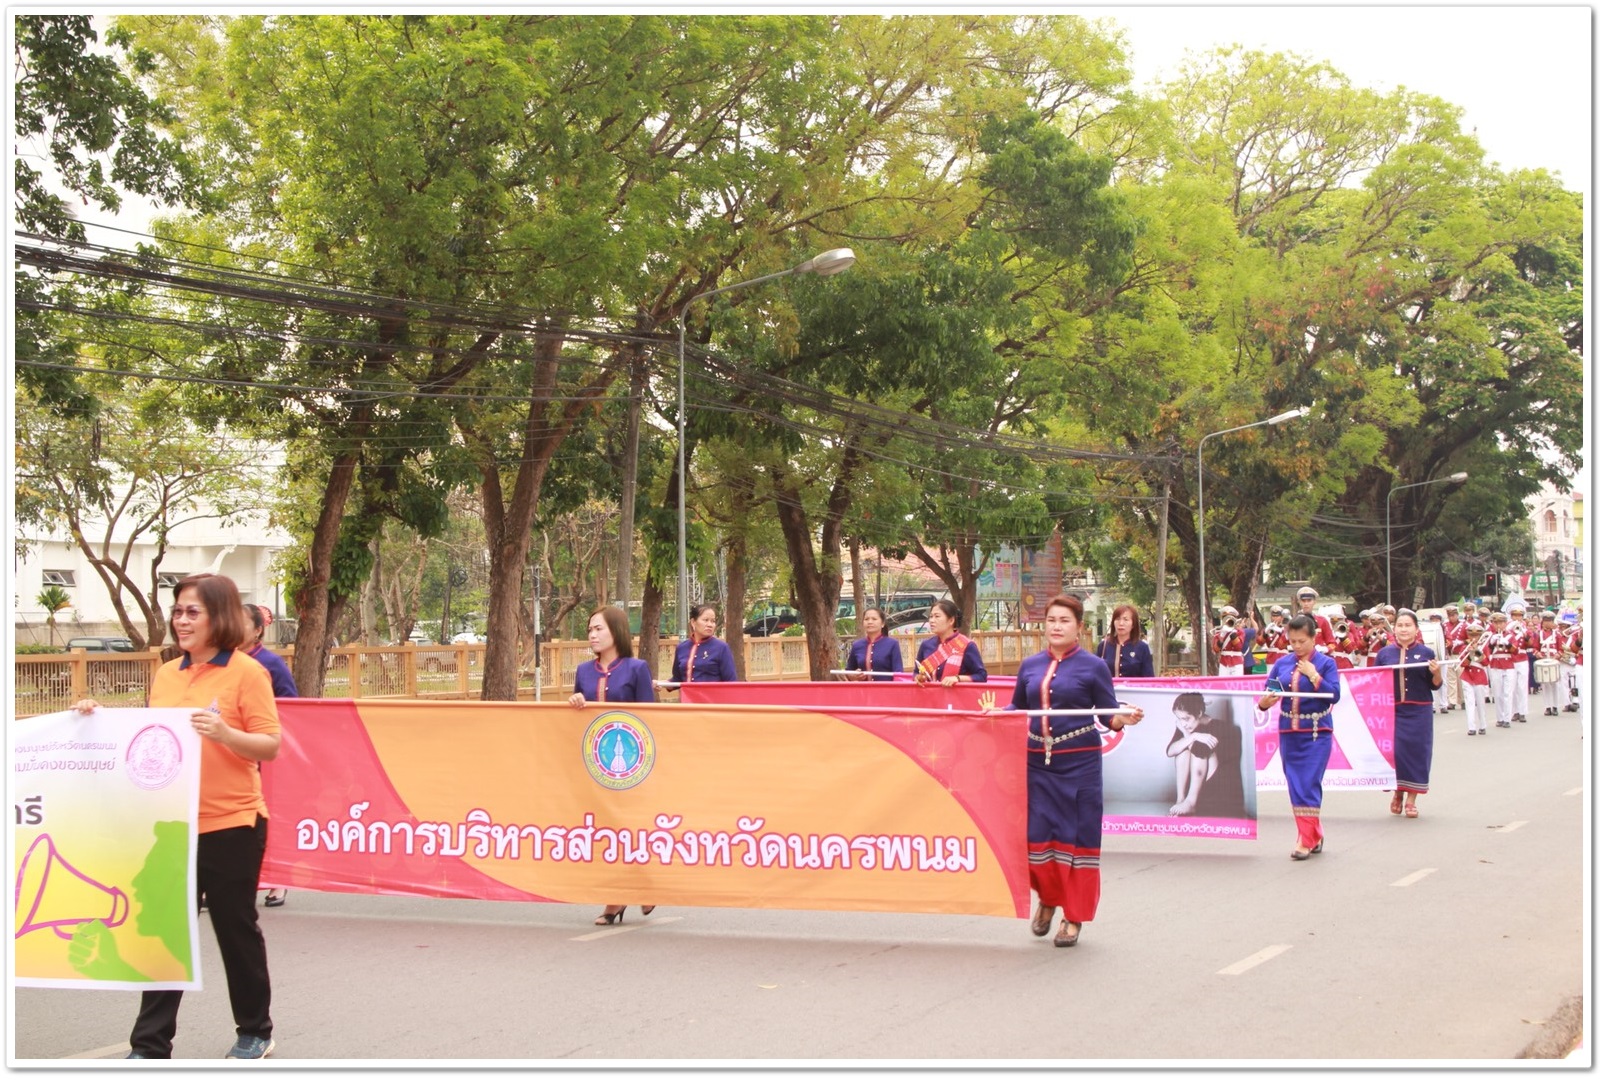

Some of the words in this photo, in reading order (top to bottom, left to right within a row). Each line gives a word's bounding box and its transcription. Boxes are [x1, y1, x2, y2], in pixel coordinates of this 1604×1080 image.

[295, 800, 978, 873] องค์การบริหารส่วนจังหวัดนครพนม
